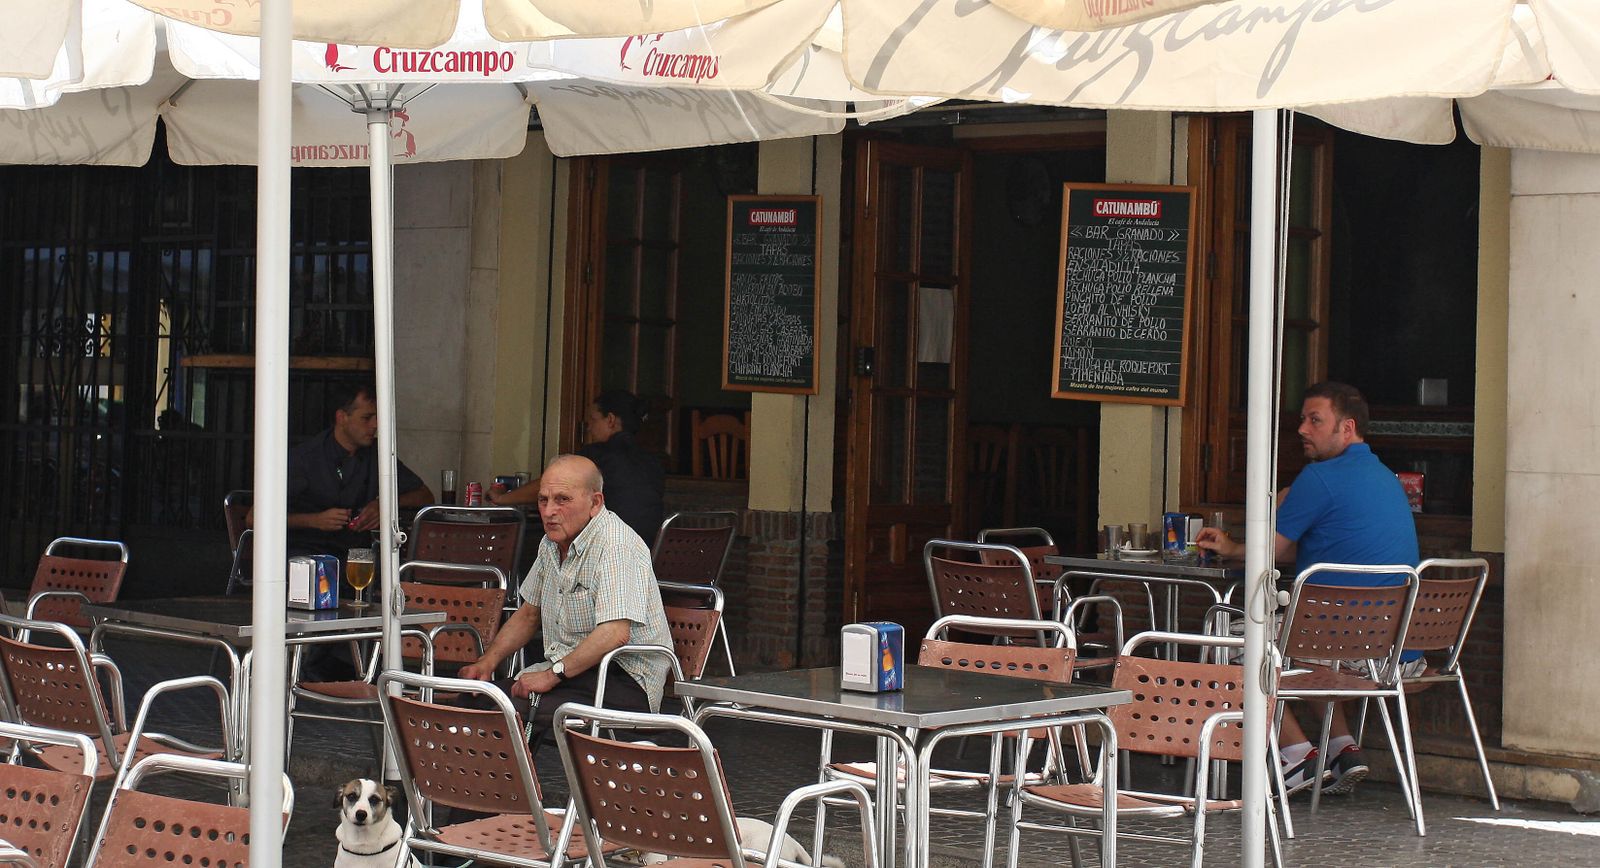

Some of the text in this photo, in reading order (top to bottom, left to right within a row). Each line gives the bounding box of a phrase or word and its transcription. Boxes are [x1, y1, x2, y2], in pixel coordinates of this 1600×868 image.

[373, 46, 514, 77] Cruzcampo
[643, 47, 719, 84] Cruzcampo
[751, 209, 795, 223] CATUNAMBÚ
[1096, 201, 1158, 216] CATUNAMBÚ
[1085, 225, 1164, 241] BAR GRANADO
[760, 243, 788, 256] TAPAS
[1108, 239, 1142, 250] TAPAS
[1068, 247, 1114, 260] RACIONES
[1130, 248, 1180, 263] RACIONES
[1066, 259, 1140, 274] ENSALADILLA
[1066, 268, 1176, 286] PECHUGA POLLO PLANCHA
[1065, 280, 1174, 297] PECHUGA POLLO RELLENA
[1065, 291, 1157, 306] PINCHITO DE POLLO
[1065, 303, 1151, 318] LOMO AL WHISKY
[1064, 311, 1166, 330] SERRANITO DE POLLO
[1064, 323, 1168, 341] SERRANITO DE CERDO
[1104, 359, 1117, 372] AL
[1120, 360, 1172, 375] ROQUEFORT
